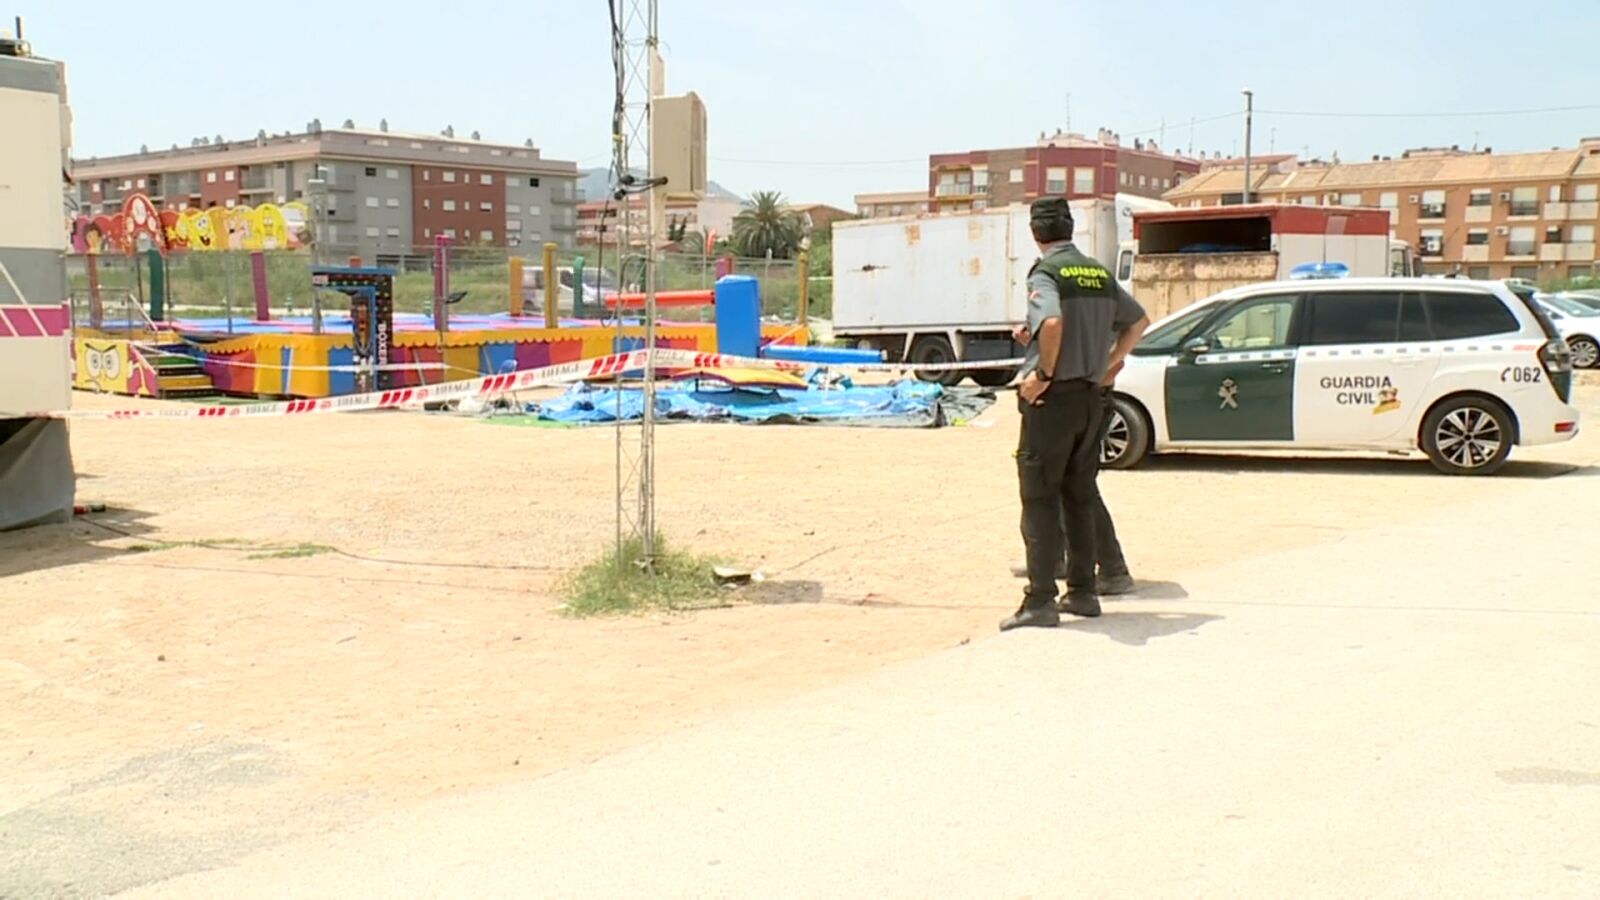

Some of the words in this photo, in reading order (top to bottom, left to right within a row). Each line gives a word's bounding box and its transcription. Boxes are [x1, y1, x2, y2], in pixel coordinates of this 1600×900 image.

[1060, 266, 1108, 278] GUARDIA
[1077, 276, 1102, 289] CIVIL
[1513, 366, 1541, 383] 062
[1319, 376, 1392, 389] GUARDIA
[1336, 391, 1376, 405] CIVIL
